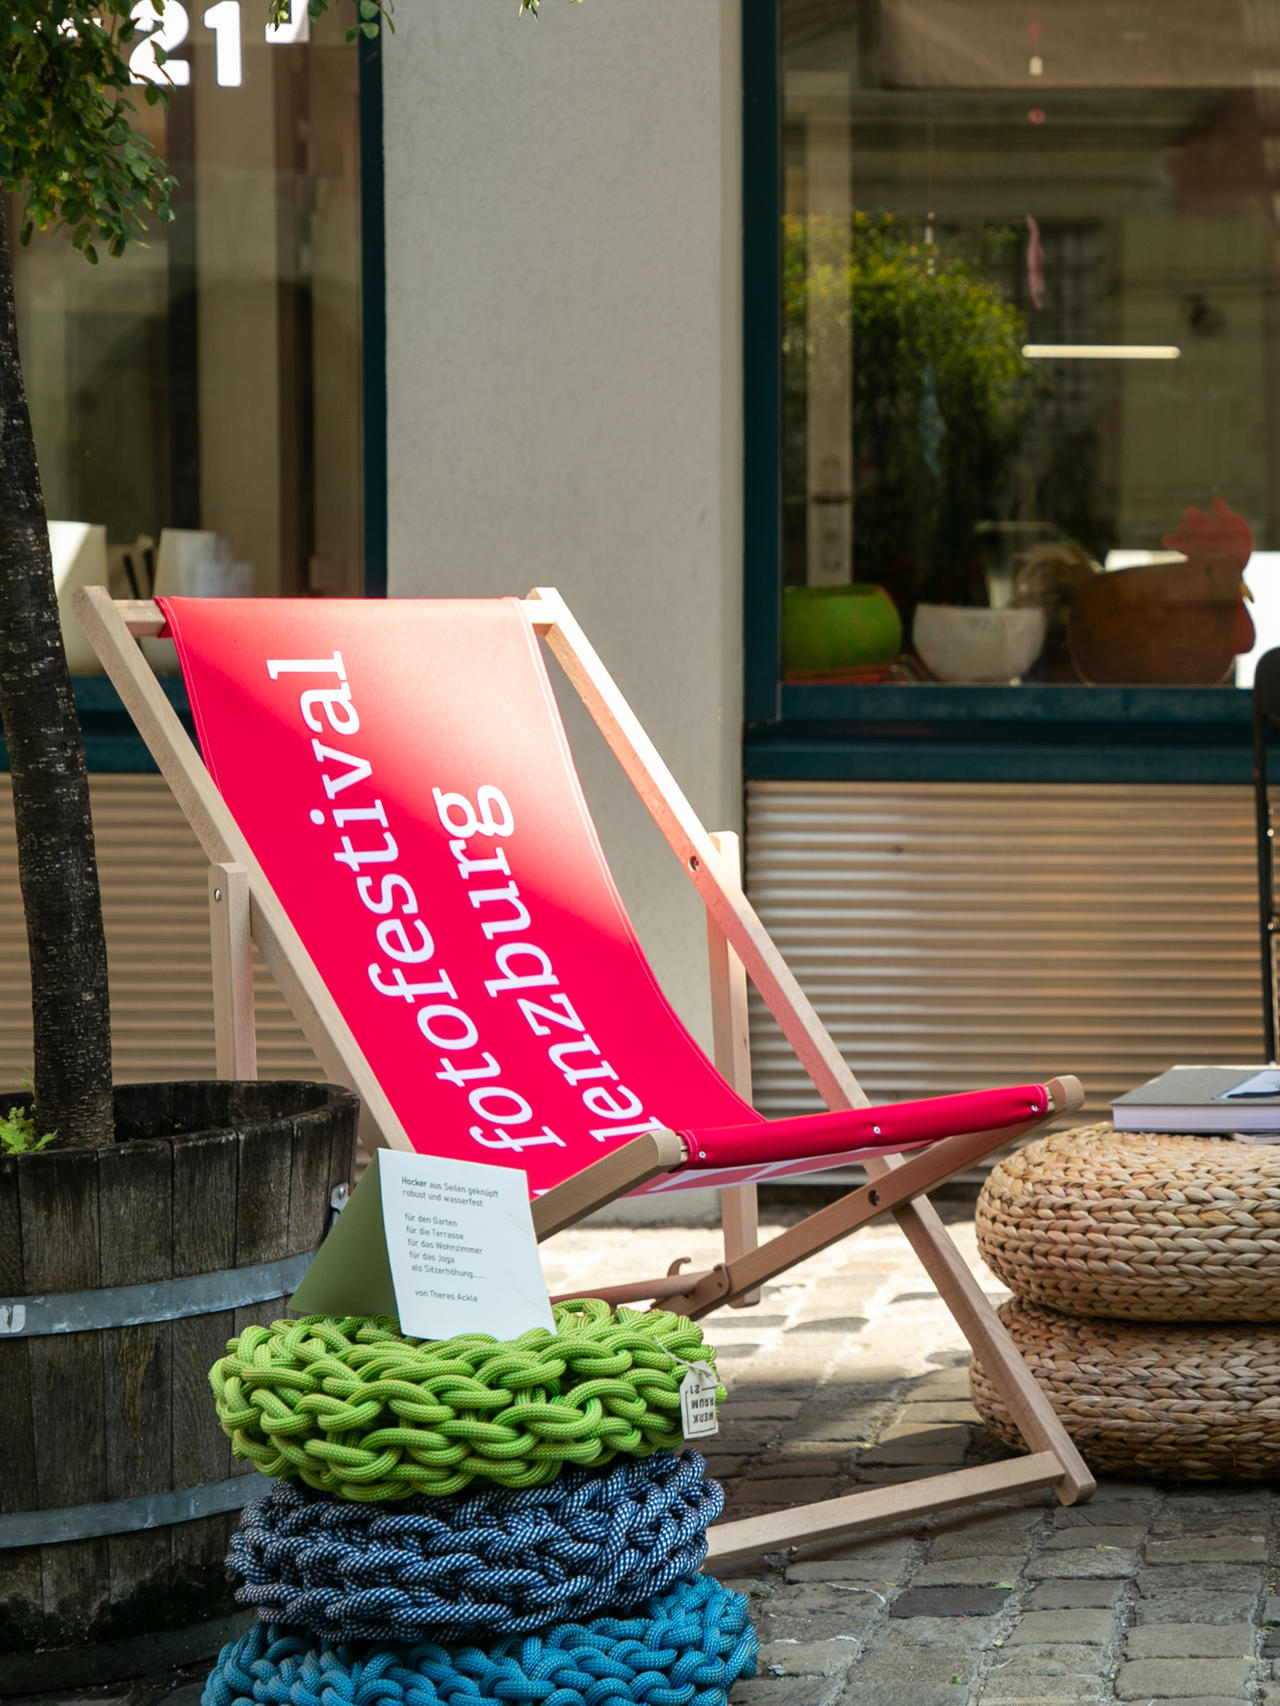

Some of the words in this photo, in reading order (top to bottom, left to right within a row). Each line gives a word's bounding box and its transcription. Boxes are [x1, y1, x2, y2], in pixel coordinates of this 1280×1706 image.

[129, 0, 242, 87] 21
[267, 651, 567, 1152] fotofestival
[432, 784, 667, 1142] lenzburg
[401, 1176, 427, 1188] Hocker
[429, 1182, 442, 1190] aus
[443, 1182, 467, 1193] Seilen
[468, 1187, 499, 1198] geknüpft
[402, 1189, 426, 1199] robust
[428, 1193, 442, 1202] und
[443, 1196, 483, 1207] wasserfest
[404, 1212, 415, 1222] für
[417, 1214, 432, 1224] den
[432, 1216, 458, 1227] Garten
[406, 1225, 417, 1235] für
[419, 1227, 430, 1236] die
[432, 1228, 464, 1240] Terrasse
[407, 1238, 418, 1247] für
[420, 1240, 434, 1249] das
[435, 1242, 483, 1254] Wohnzimmer
[409, 1250, 420, 1260] für
[422, 1253, 436, 1262] das
[438, 1254, 455, 1264] Joga
[411, 1264, 422, 1272] als
[415, 1289, 428, 1297] von
[429, 1290, 455, 1300] Theres
[689, 1384, 700, 1394] 21
[692, 1412, 714, 1424] WERK
